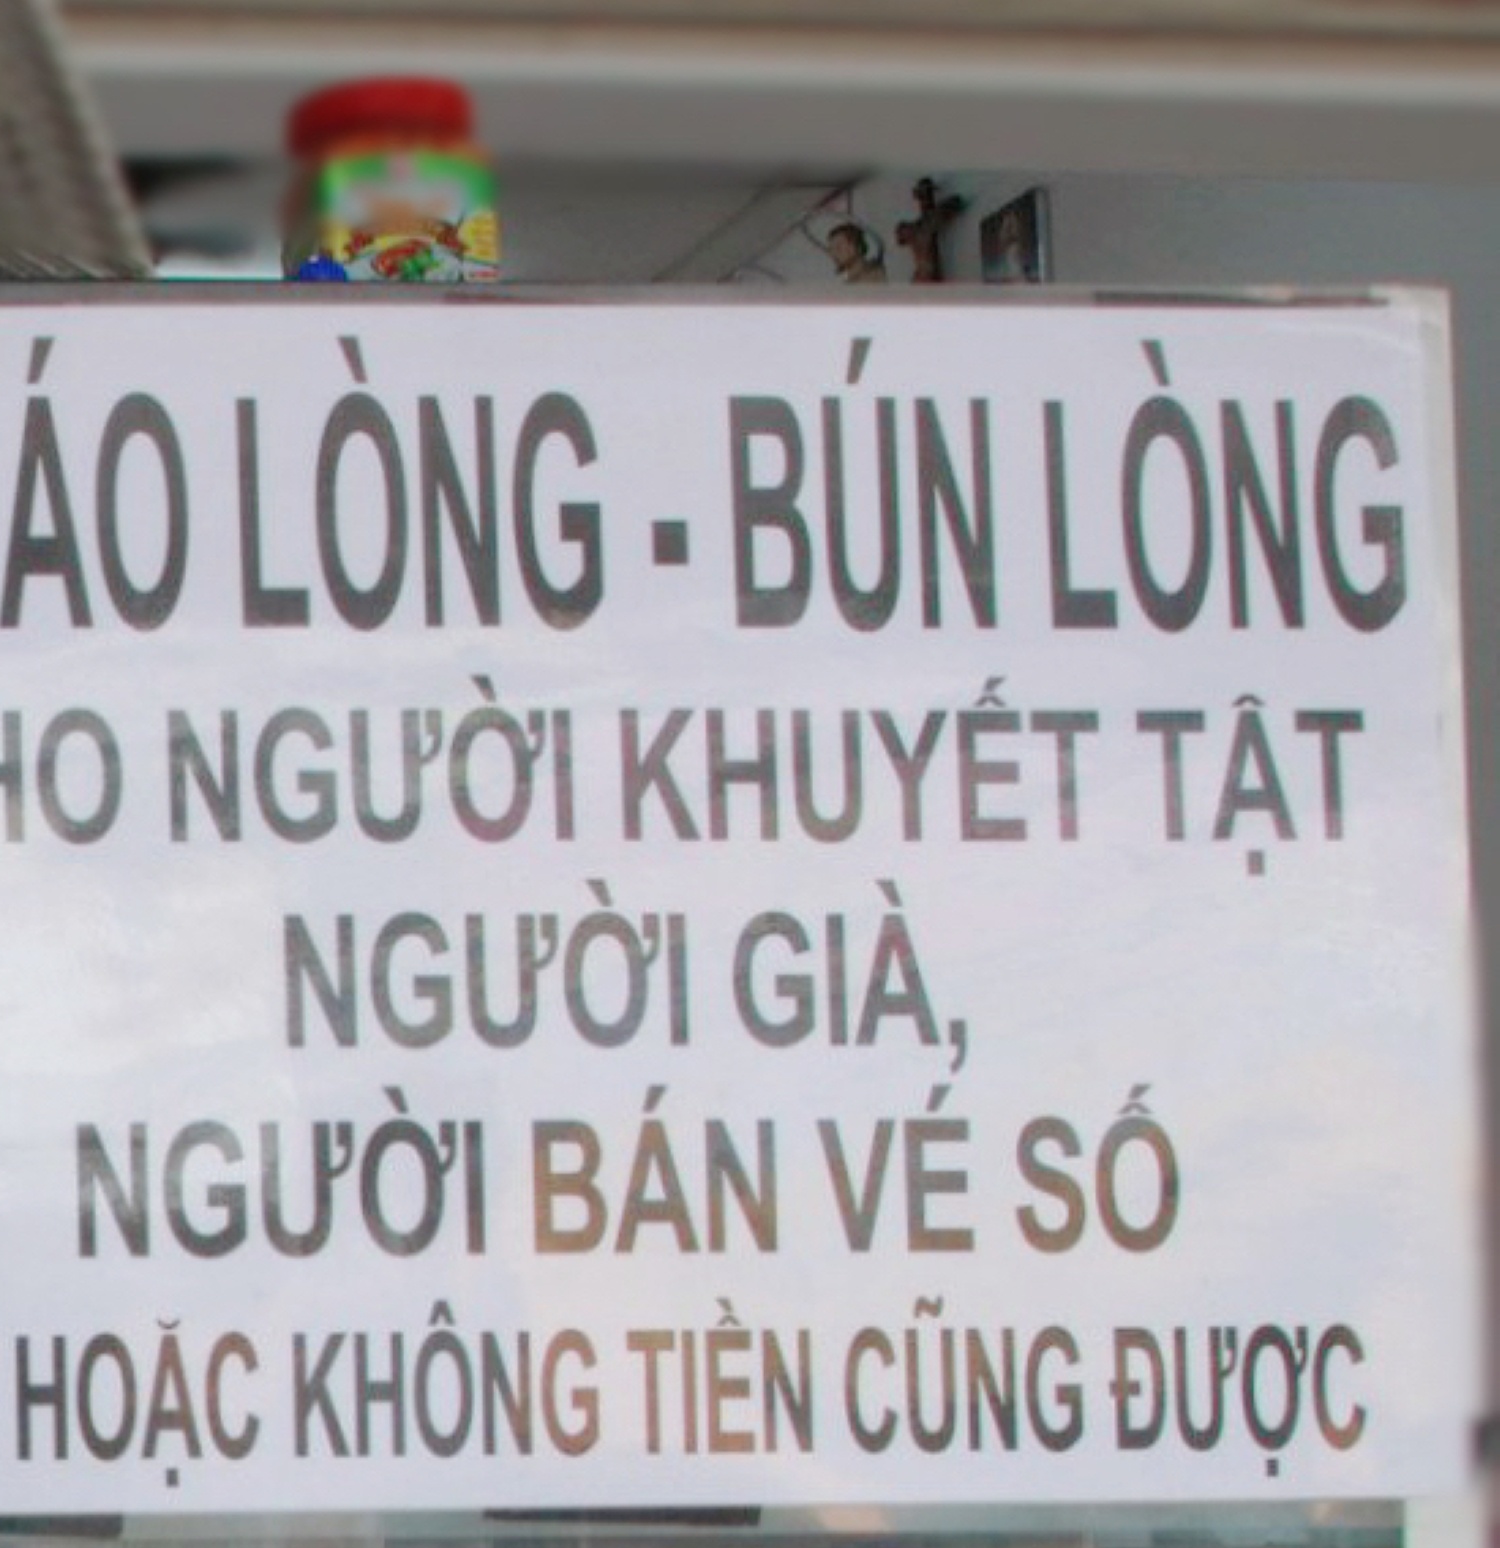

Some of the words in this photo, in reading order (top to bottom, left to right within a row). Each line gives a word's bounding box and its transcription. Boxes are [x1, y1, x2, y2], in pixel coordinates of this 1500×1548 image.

[236, 336, 604, 631] LÒNG
[729, 337, 997, 632] BÚN
[1043, 340, 1406, 633] LÒNG
[167, 674, 575, 844] NGƯỜI
[619, 676, 1100, 843] KHUYẾT
[1136, 693, 1365, 875] TẬT
[284, 879, 690, 1049] NGƯỜI
[733, 879, 967, 1073] GIÀ,
[77, 1086, 485, 1259] NGƯỜI
[532, 1084, 778, 1253] BÁN
[817, 1084, 975, 1252] VÉ
[1016, 1084, 1180, 1253] SỐ
[15, 1321, 259, 1487] HOẶC
[292, 1299, 599, 1458] KHÔNG
[626, 1298, 814, 1455] TIỀN
[845, 1297, 1084, 1454] CŨNG
[1109, 1324, 1366, 1477] ĐƯỢC
